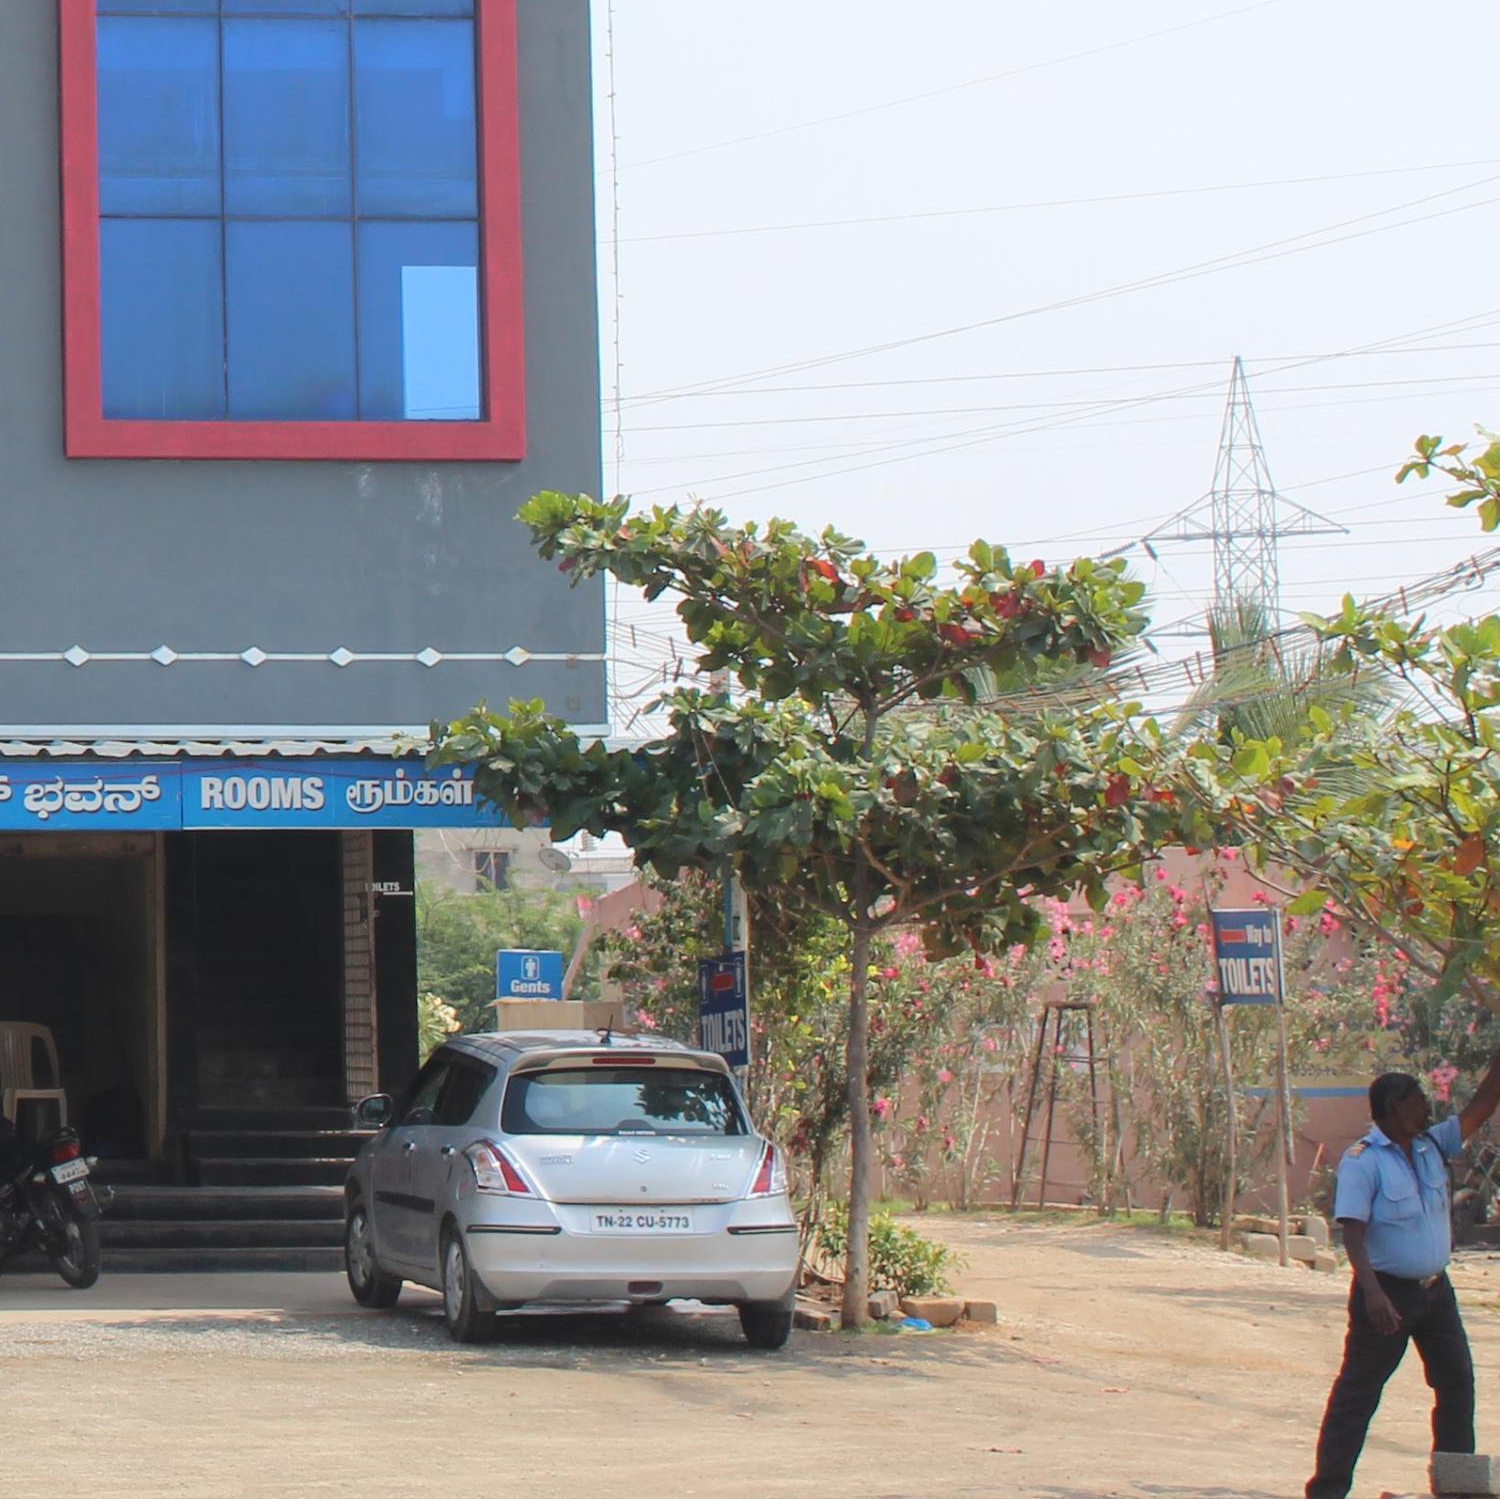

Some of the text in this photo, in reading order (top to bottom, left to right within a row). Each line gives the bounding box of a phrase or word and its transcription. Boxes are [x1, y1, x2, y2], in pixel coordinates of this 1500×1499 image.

[24, 775, 161, 819] ಭವನ್
[201, 776, 325, 811] ROOMS
[510, 979, 551, 994] Gents
[1219, 957, 1275, 995] TOILETS
[702, 1009, 746, 1052] TOILETS
[596, 1215, 690, 1229] TN-22 CU-5773
